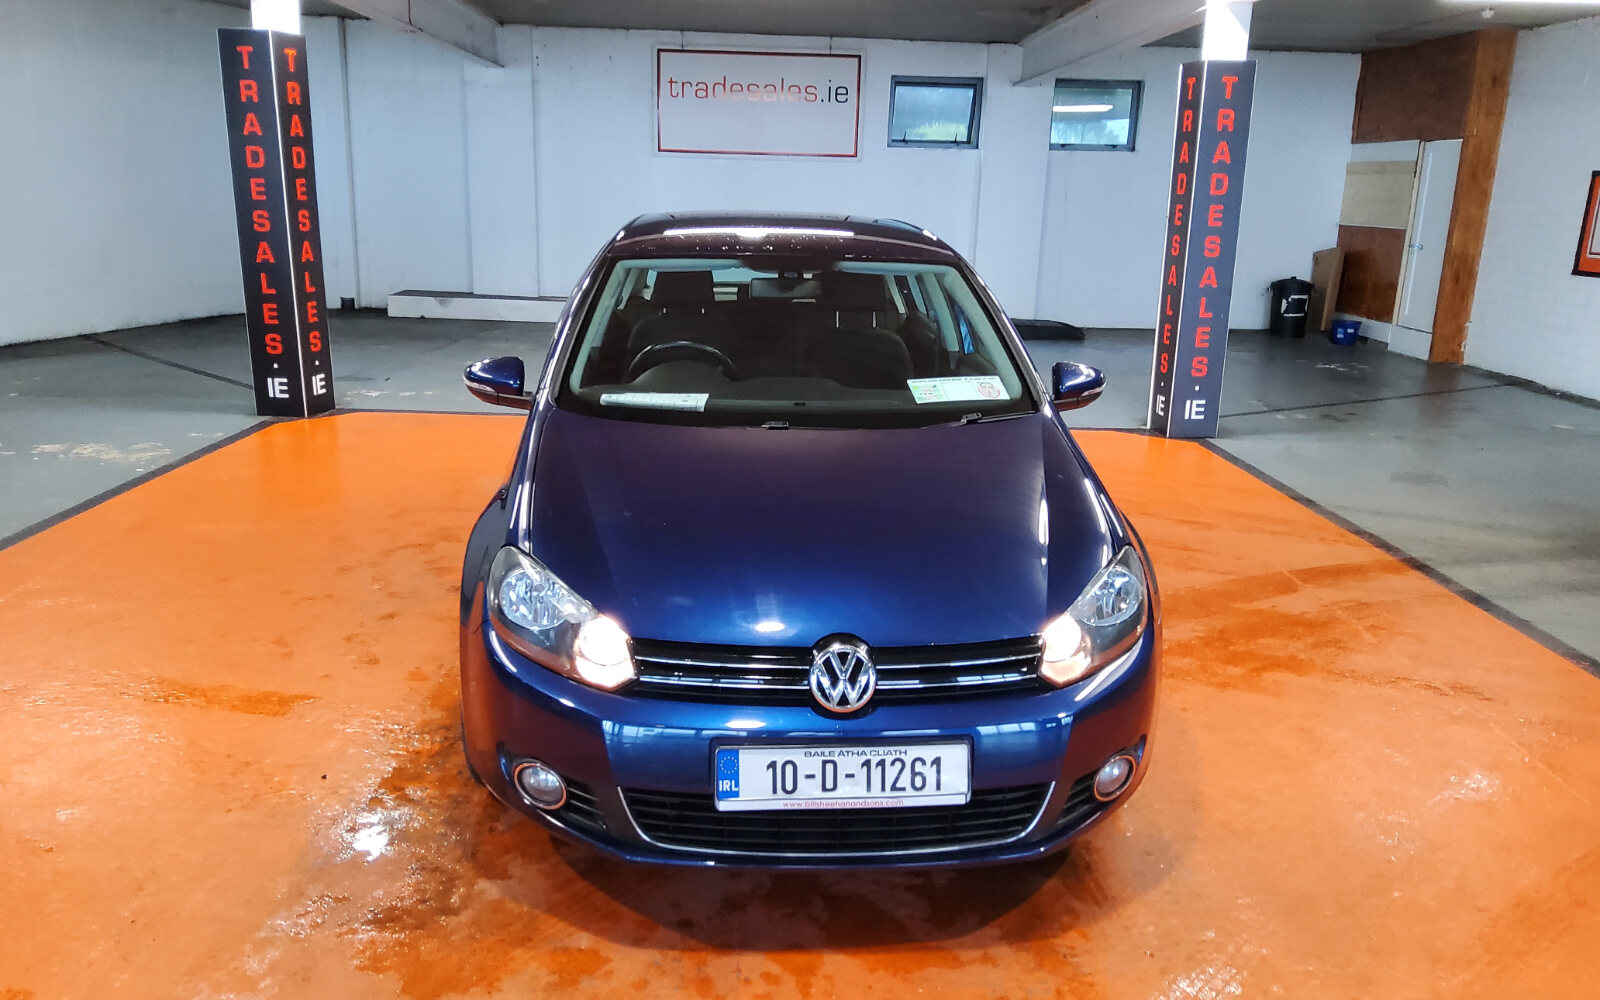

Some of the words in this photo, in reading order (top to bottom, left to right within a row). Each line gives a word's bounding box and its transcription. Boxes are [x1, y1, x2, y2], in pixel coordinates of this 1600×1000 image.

[667, 75, 849, 104] tradesales.ie
[804, 750, 836, 758] BAILE
[869, 748, 908, 757] CLIATH
[718, 779, 739, 792] IRL
[766, 756, 942, 795] 10-D-11261
